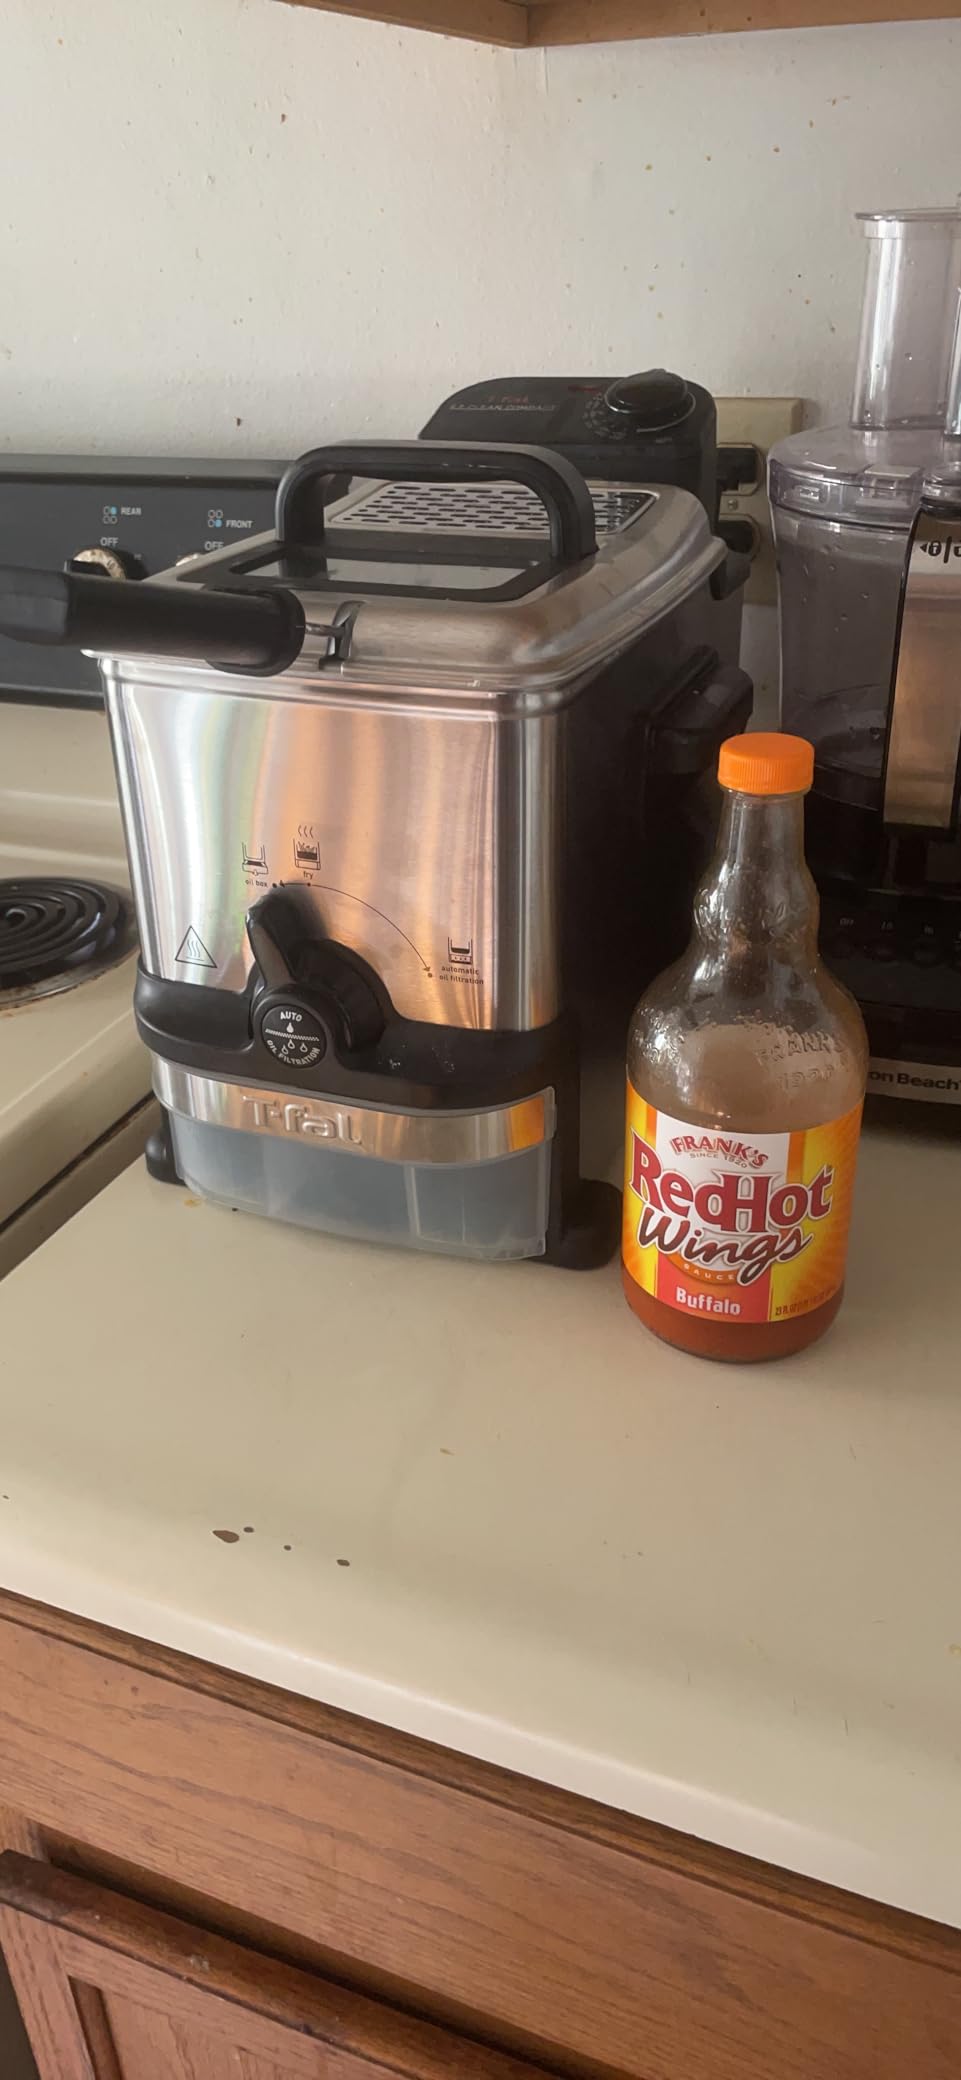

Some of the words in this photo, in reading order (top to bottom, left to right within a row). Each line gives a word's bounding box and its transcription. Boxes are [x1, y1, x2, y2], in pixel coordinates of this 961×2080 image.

[120, 506, 142, 516] REAR
[226, 519, 253, 529] FRONT
[100, 536, 119, 548] OFF
[204, 540, 225, 551] OFF
[303, 870, 314, 880] fry
[256, 879, 268, 888] box
[441, 965, 480, 976] automatic
[439, 974, 449, 982] oil
[450, 975, 484, 985] filtration
[280, 1011, 303, 1022] AUTO
[266, 1040, 278, 1054] OIL
[278, 1047, 321, 1065] FILTRATION
[897, 1073, 959, 1091] Beach
[242, 1095, 363, 1146] T-fal
[669, 1135, 769, 1169] FRANK'S
[689, 1152, 719, 1160] SINCE
[723, 1155, 748, 1169] 1920
[639, 1207, 812, 1285] Wings
[683, 1262, 735, 1281] SAUCE
[676, 1287, 741, 1315] Buffalo
